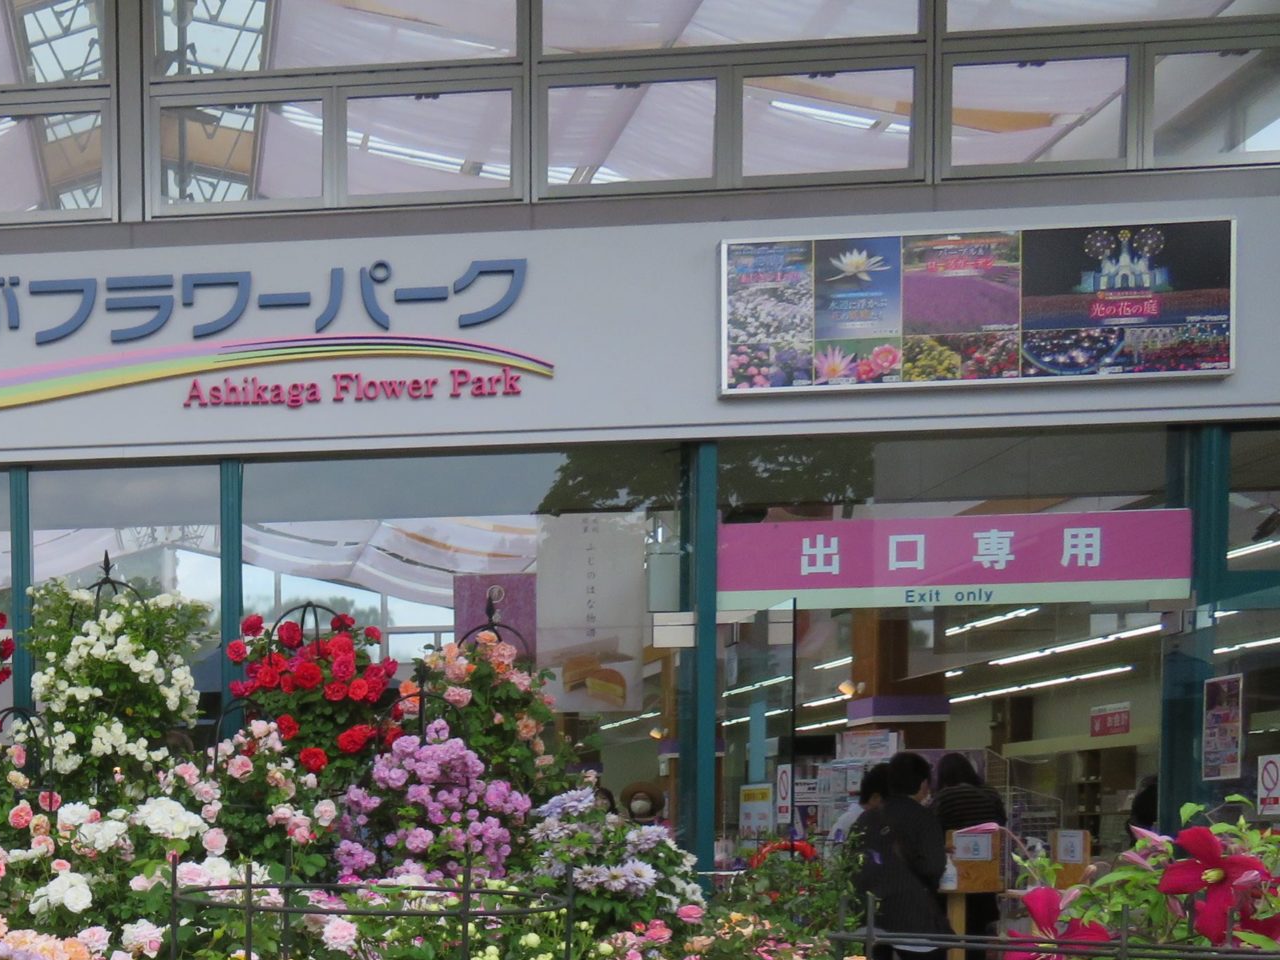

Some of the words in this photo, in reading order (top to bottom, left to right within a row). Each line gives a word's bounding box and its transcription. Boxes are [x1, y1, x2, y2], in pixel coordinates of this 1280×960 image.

[1091, 300, 1159, 317] 光の花の庭
[185, 377, 321, 408] Ashikaga
[333, 371, 438, 402] Flower
[450, 366, 521, 398] Park
[801, 527, 1101, 576] 出口専用
[905, 589, 941, 603] Exit
[955, 587, 993, 602] only
